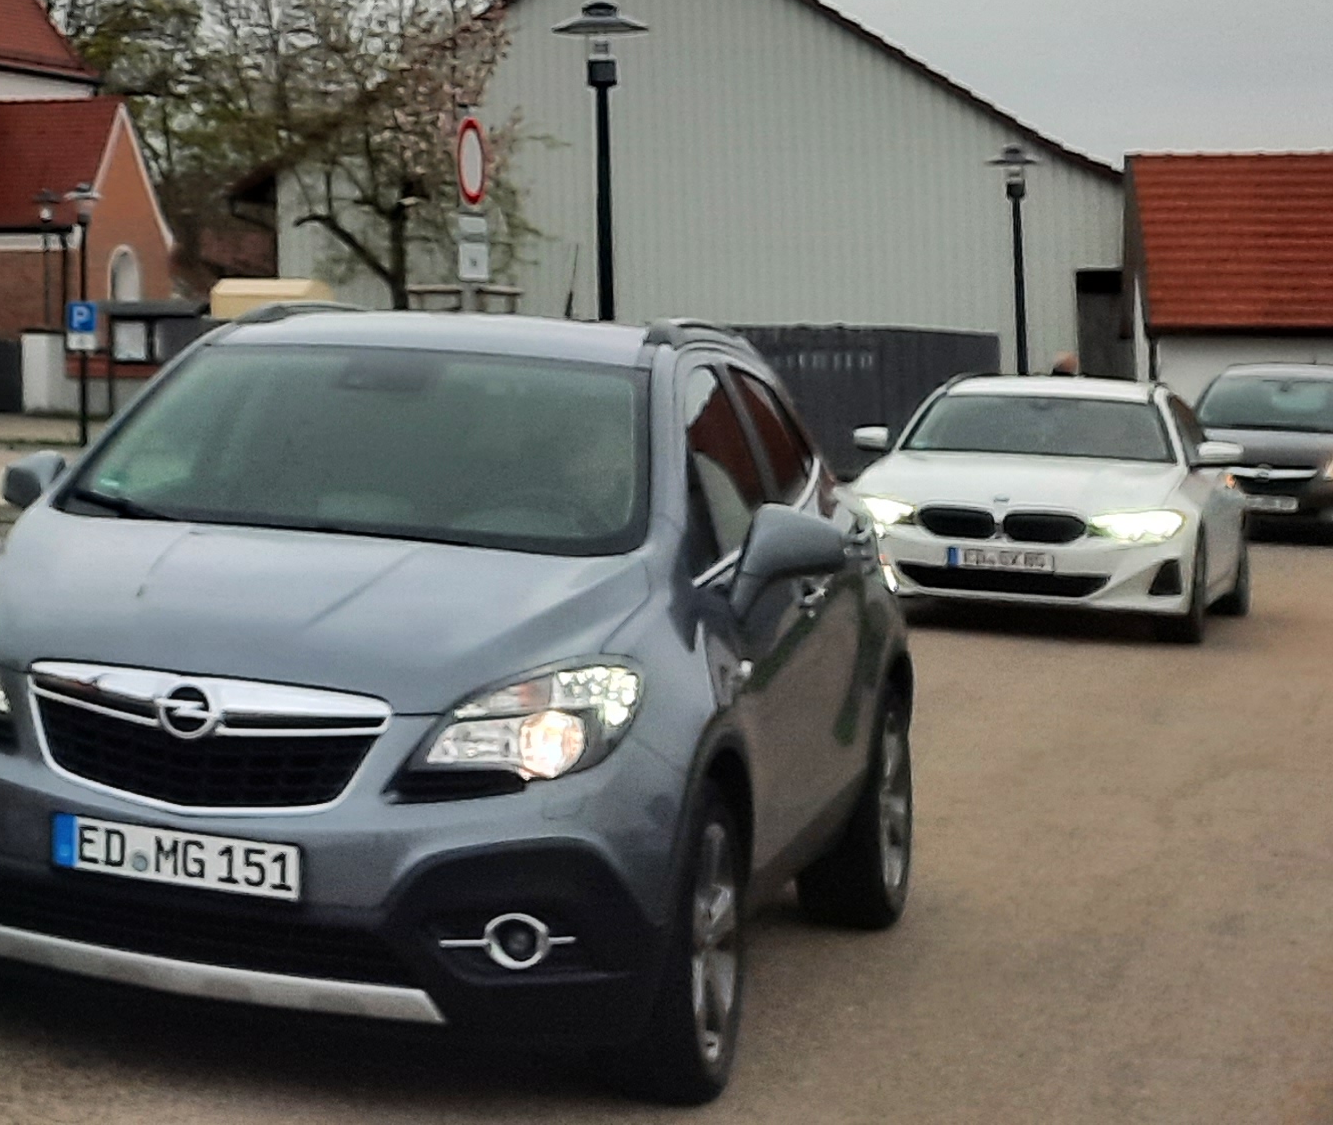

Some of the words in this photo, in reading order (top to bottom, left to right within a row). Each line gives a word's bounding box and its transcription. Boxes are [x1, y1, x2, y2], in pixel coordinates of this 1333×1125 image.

[72, 307, 90, 330] P
[79, 827, 126, 867] ED
[155, 837, 205, 879] MG
[218, 845, 292, 891] 151
